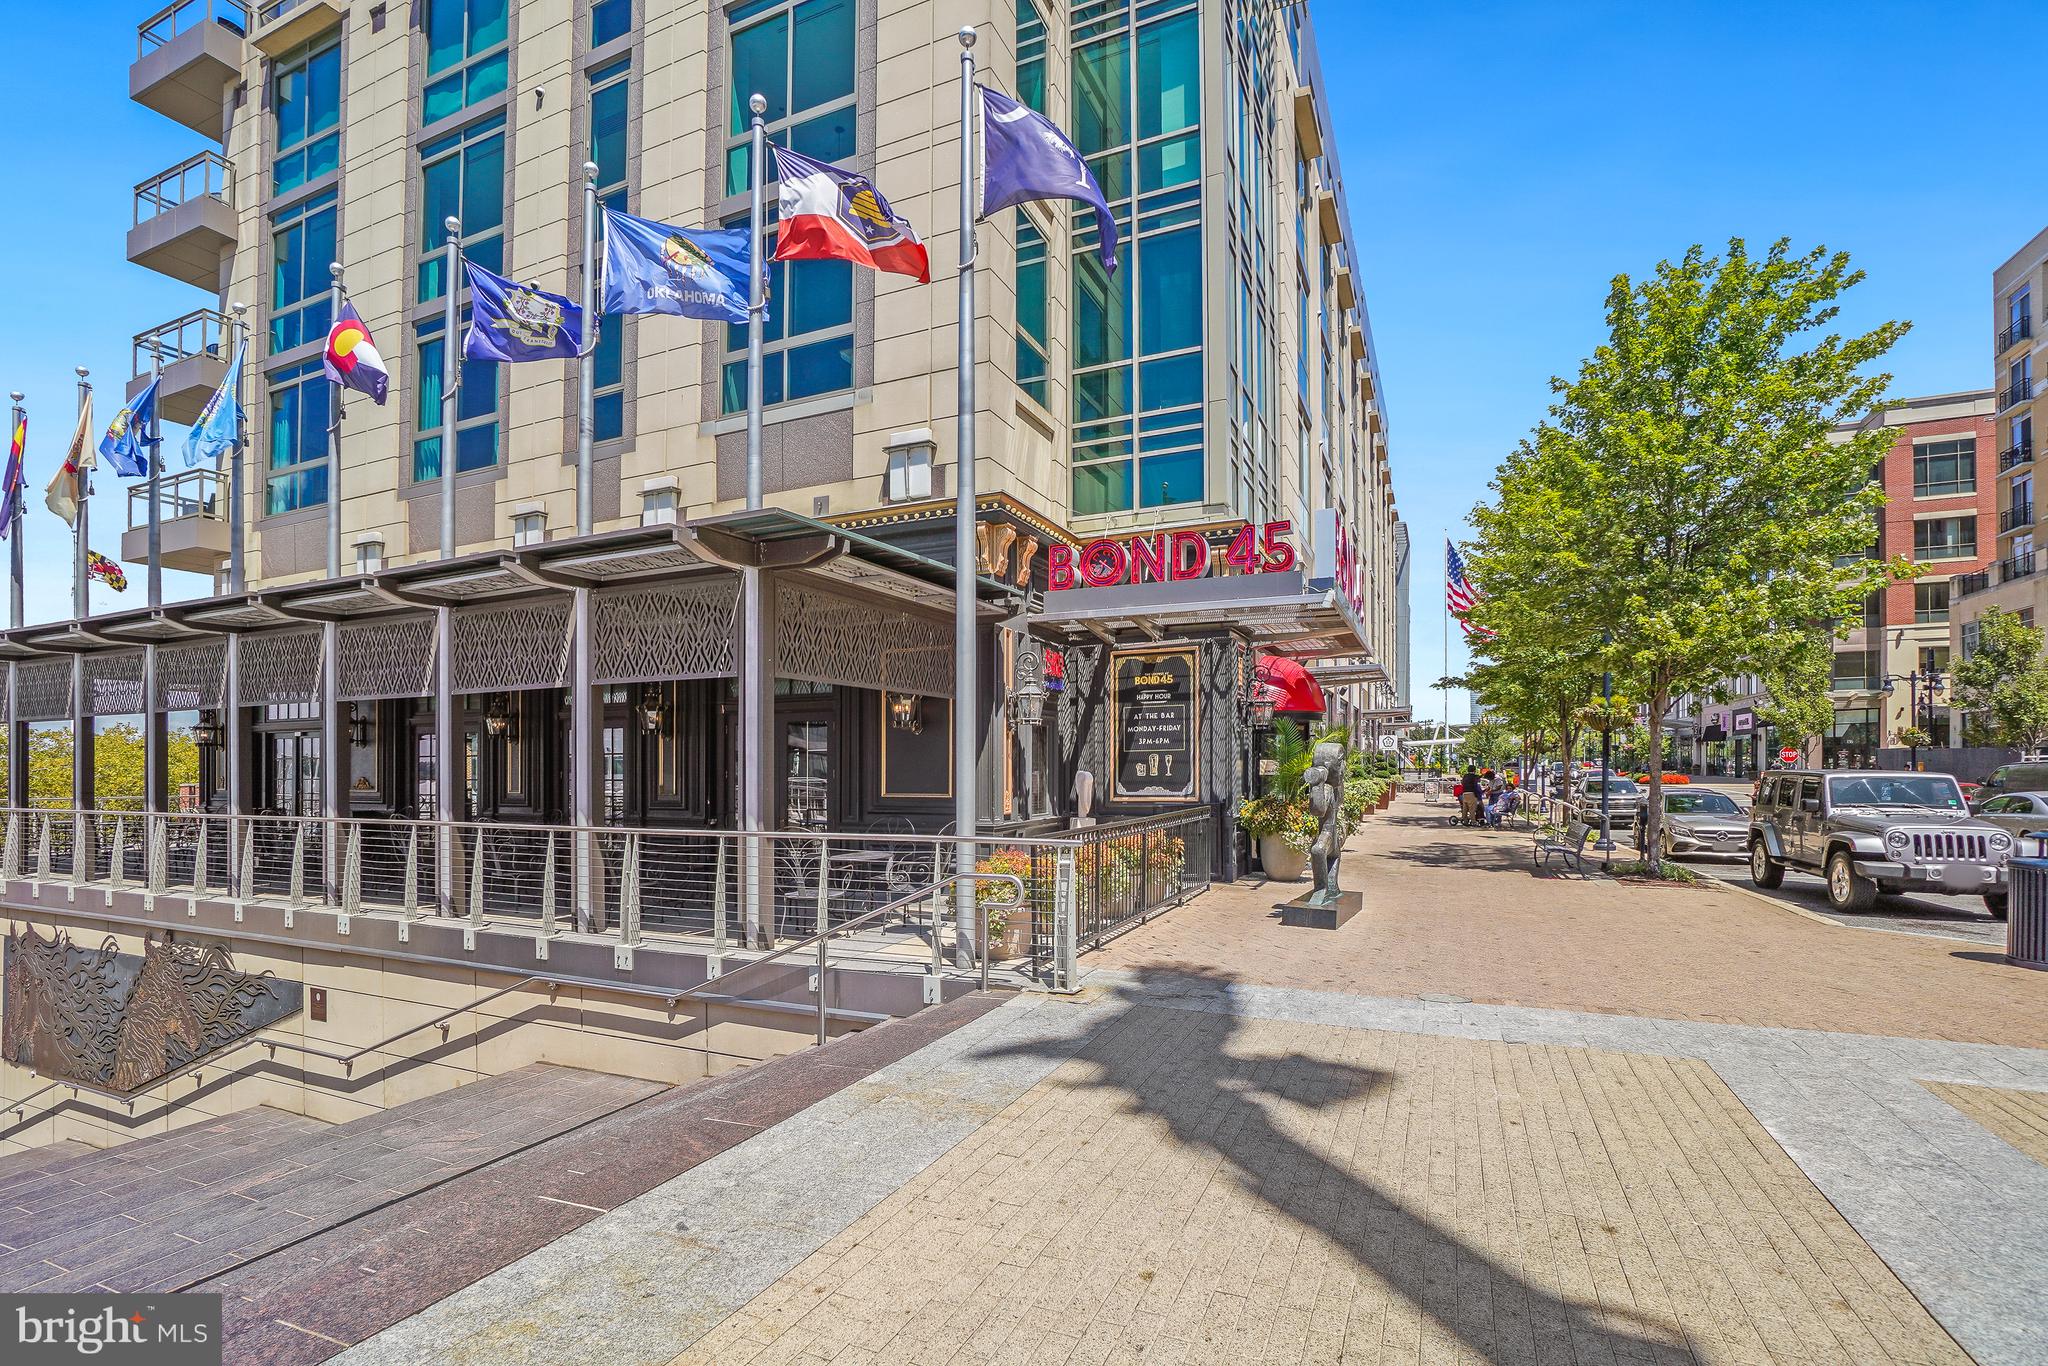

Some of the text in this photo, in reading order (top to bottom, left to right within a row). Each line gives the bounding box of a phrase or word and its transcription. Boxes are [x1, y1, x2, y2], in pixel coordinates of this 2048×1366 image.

[647, 286, 725, 306] OKLAHOMA
[1049, 520, 1296, 591] BOND 45
[1134, 674, 1174, 685] BOND 45
[1127, 724, 1181, 732] MONDAY-FRIDAY
[1138, 737, 1170, 745] 3PM-6PM
